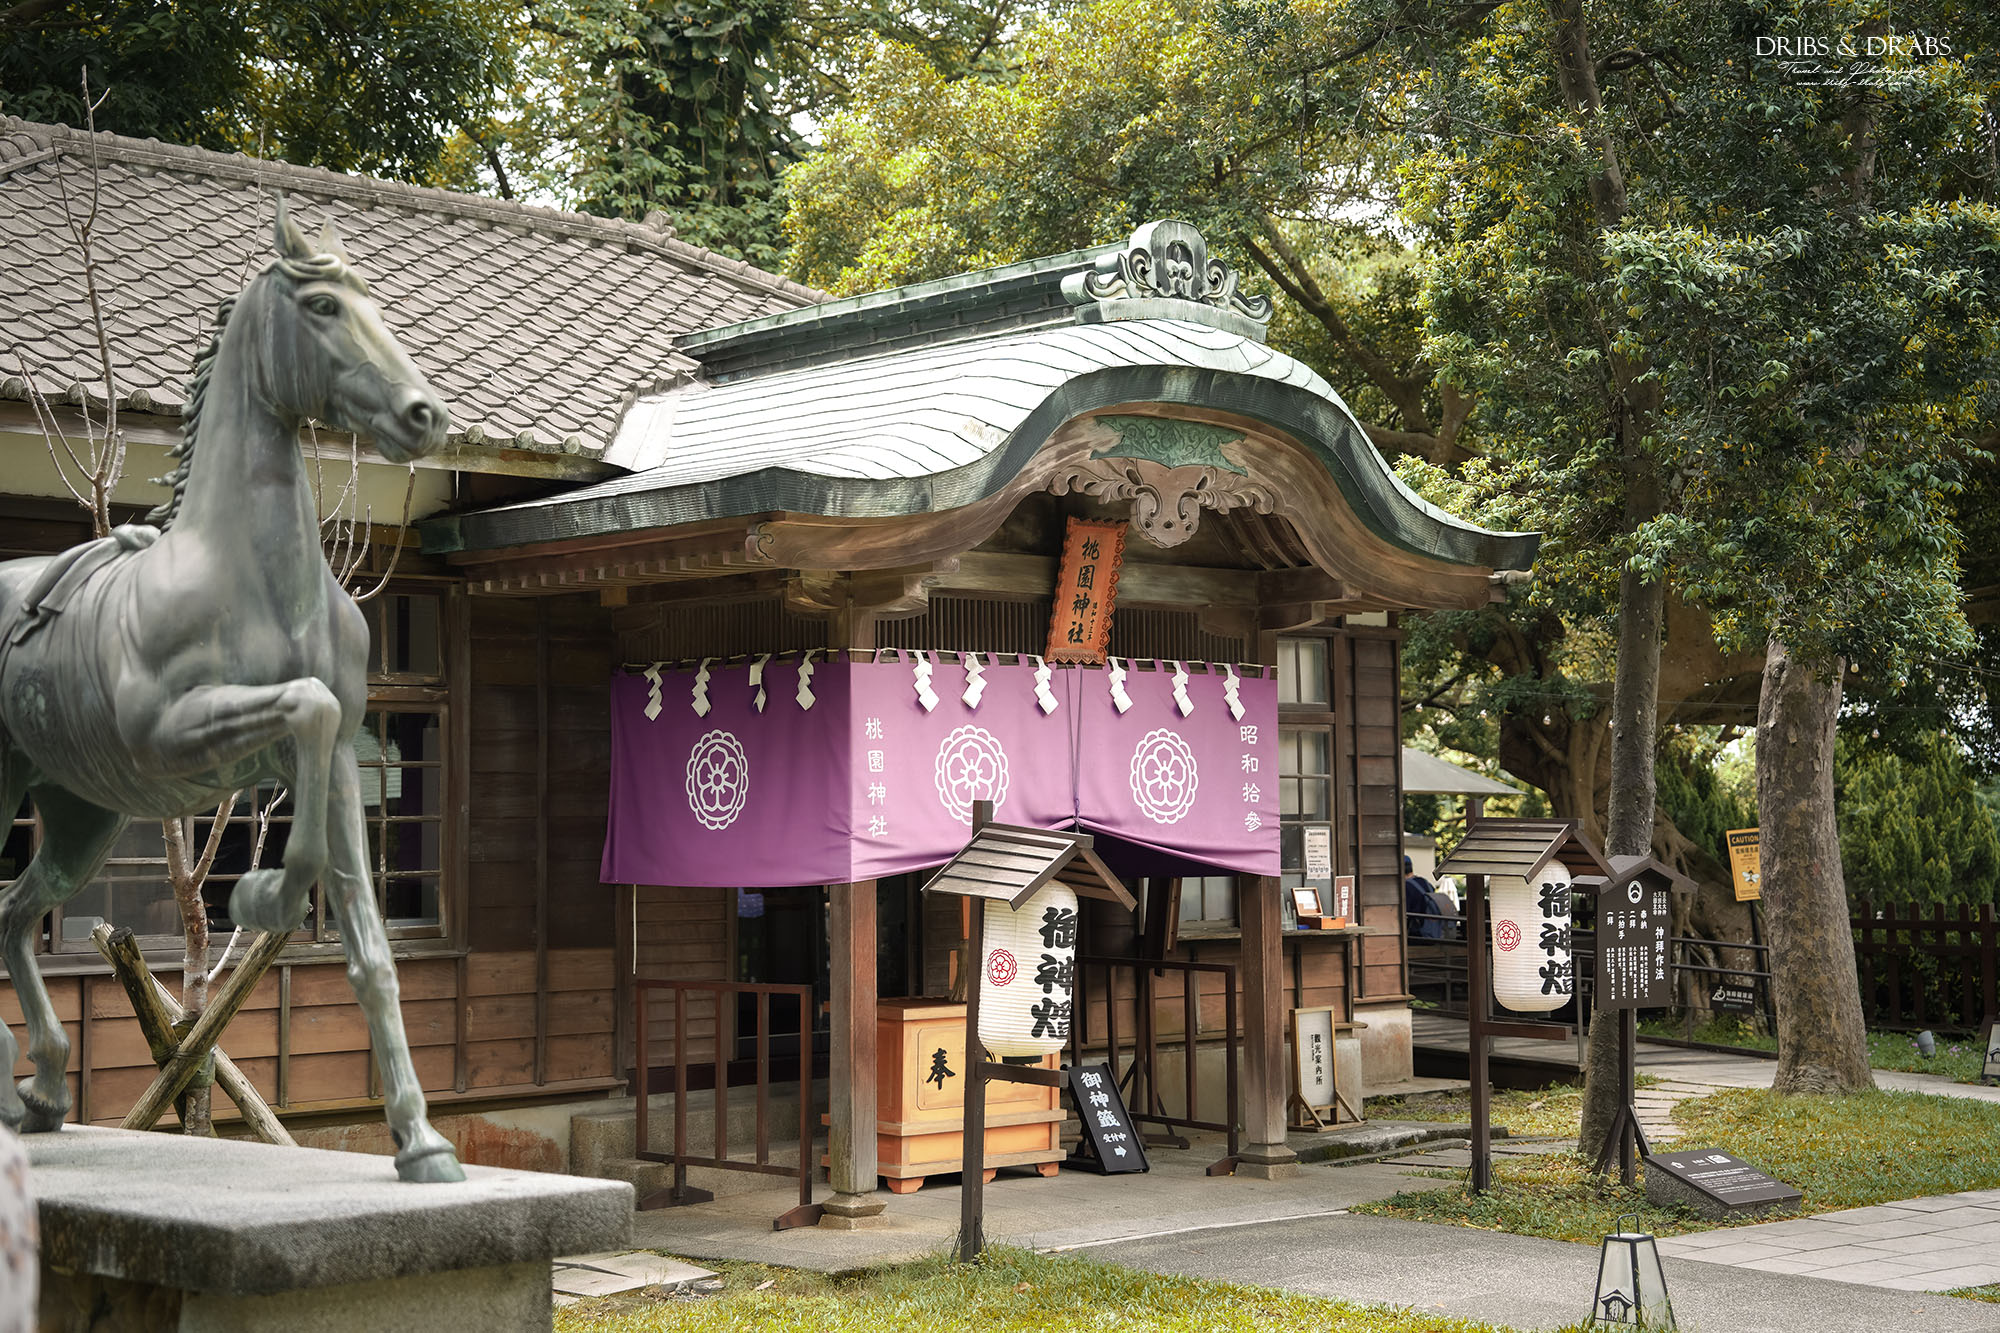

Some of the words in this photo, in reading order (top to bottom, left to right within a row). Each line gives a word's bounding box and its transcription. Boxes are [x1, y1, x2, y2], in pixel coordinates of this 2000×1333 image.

[865, 717, 888, 838] 桃園神社
[1239, 725, 1263, 832] 昭和拾參
[1731, 834, 1759, 844] CAUTION
[926, 1048, 956, 1090] 奉
[1103, 1132, 1127, 1143] 受付中
